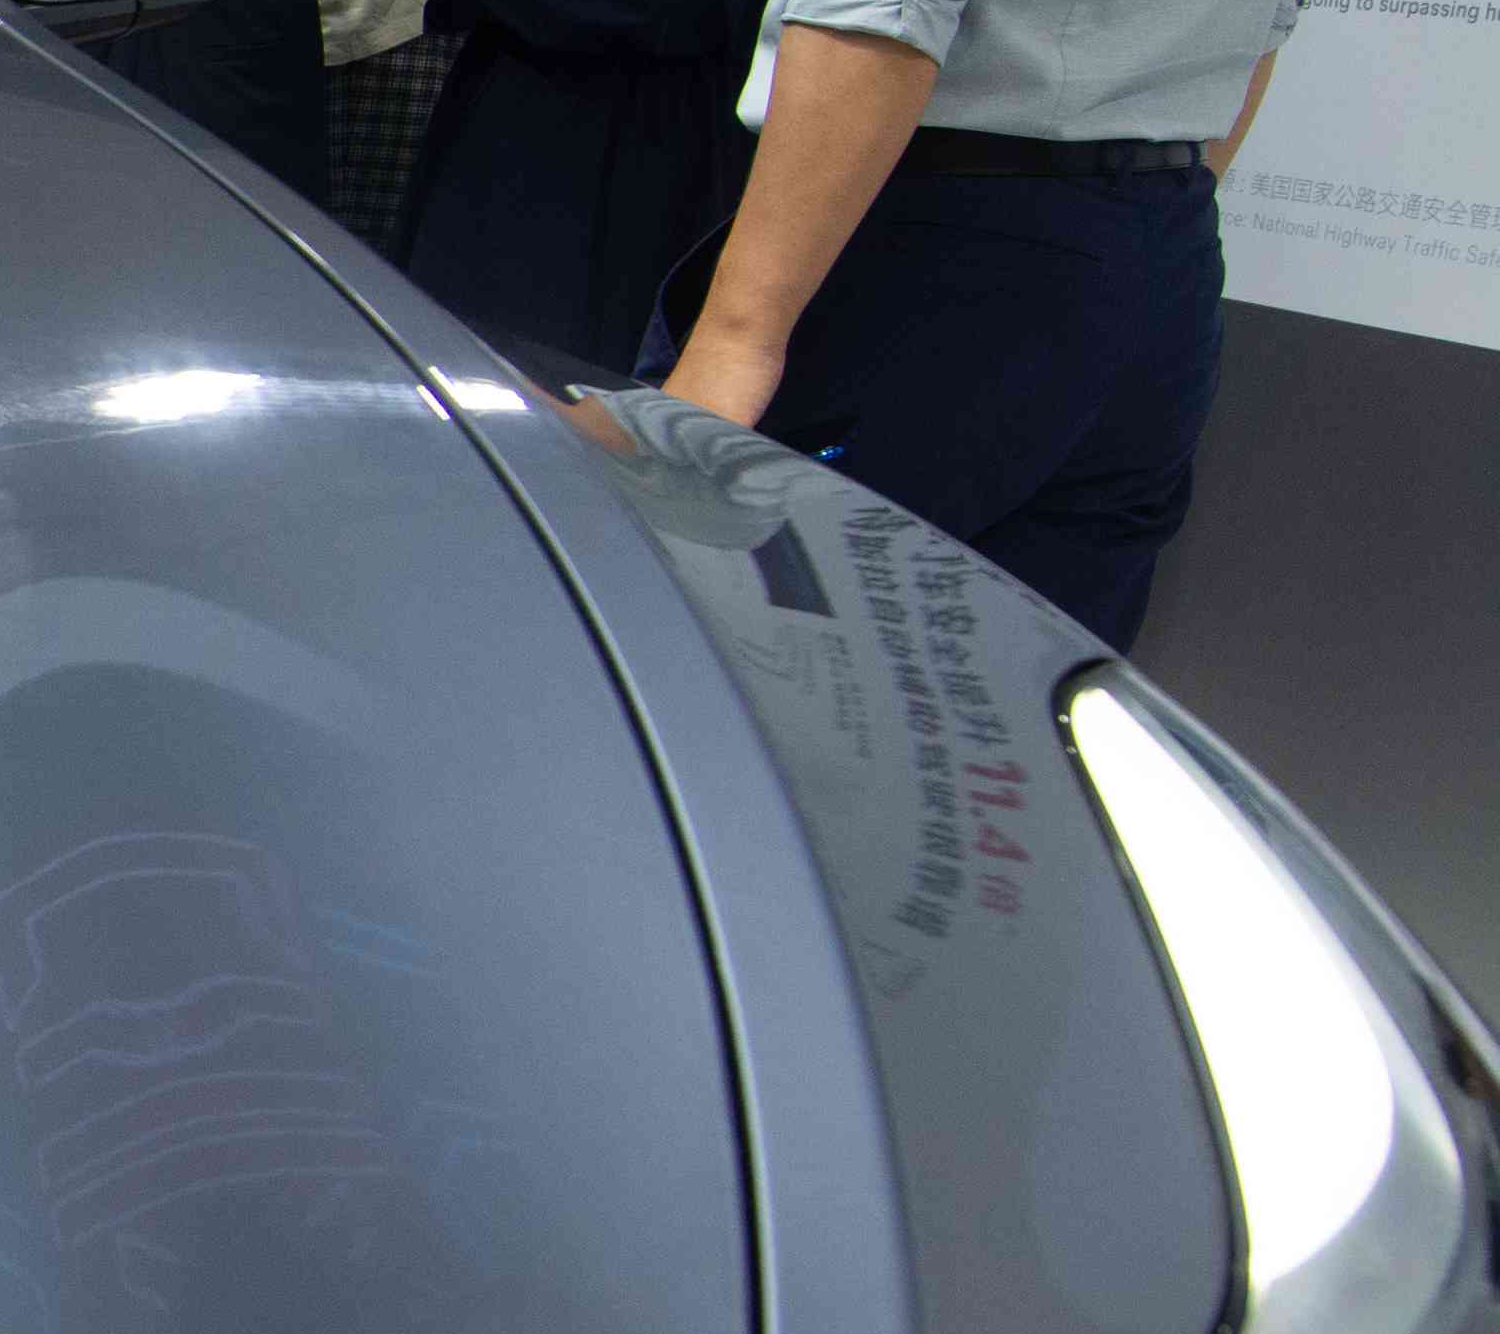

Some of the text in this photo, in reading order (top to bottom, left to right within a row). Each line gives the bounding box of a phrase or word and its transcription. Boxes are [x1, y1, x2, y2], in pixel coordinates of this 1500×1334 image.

[1252, 212, 1320, 239] National
[1323, 222, 1397, 254] Highway
[1403, 234, 1461, 262] Traffic
